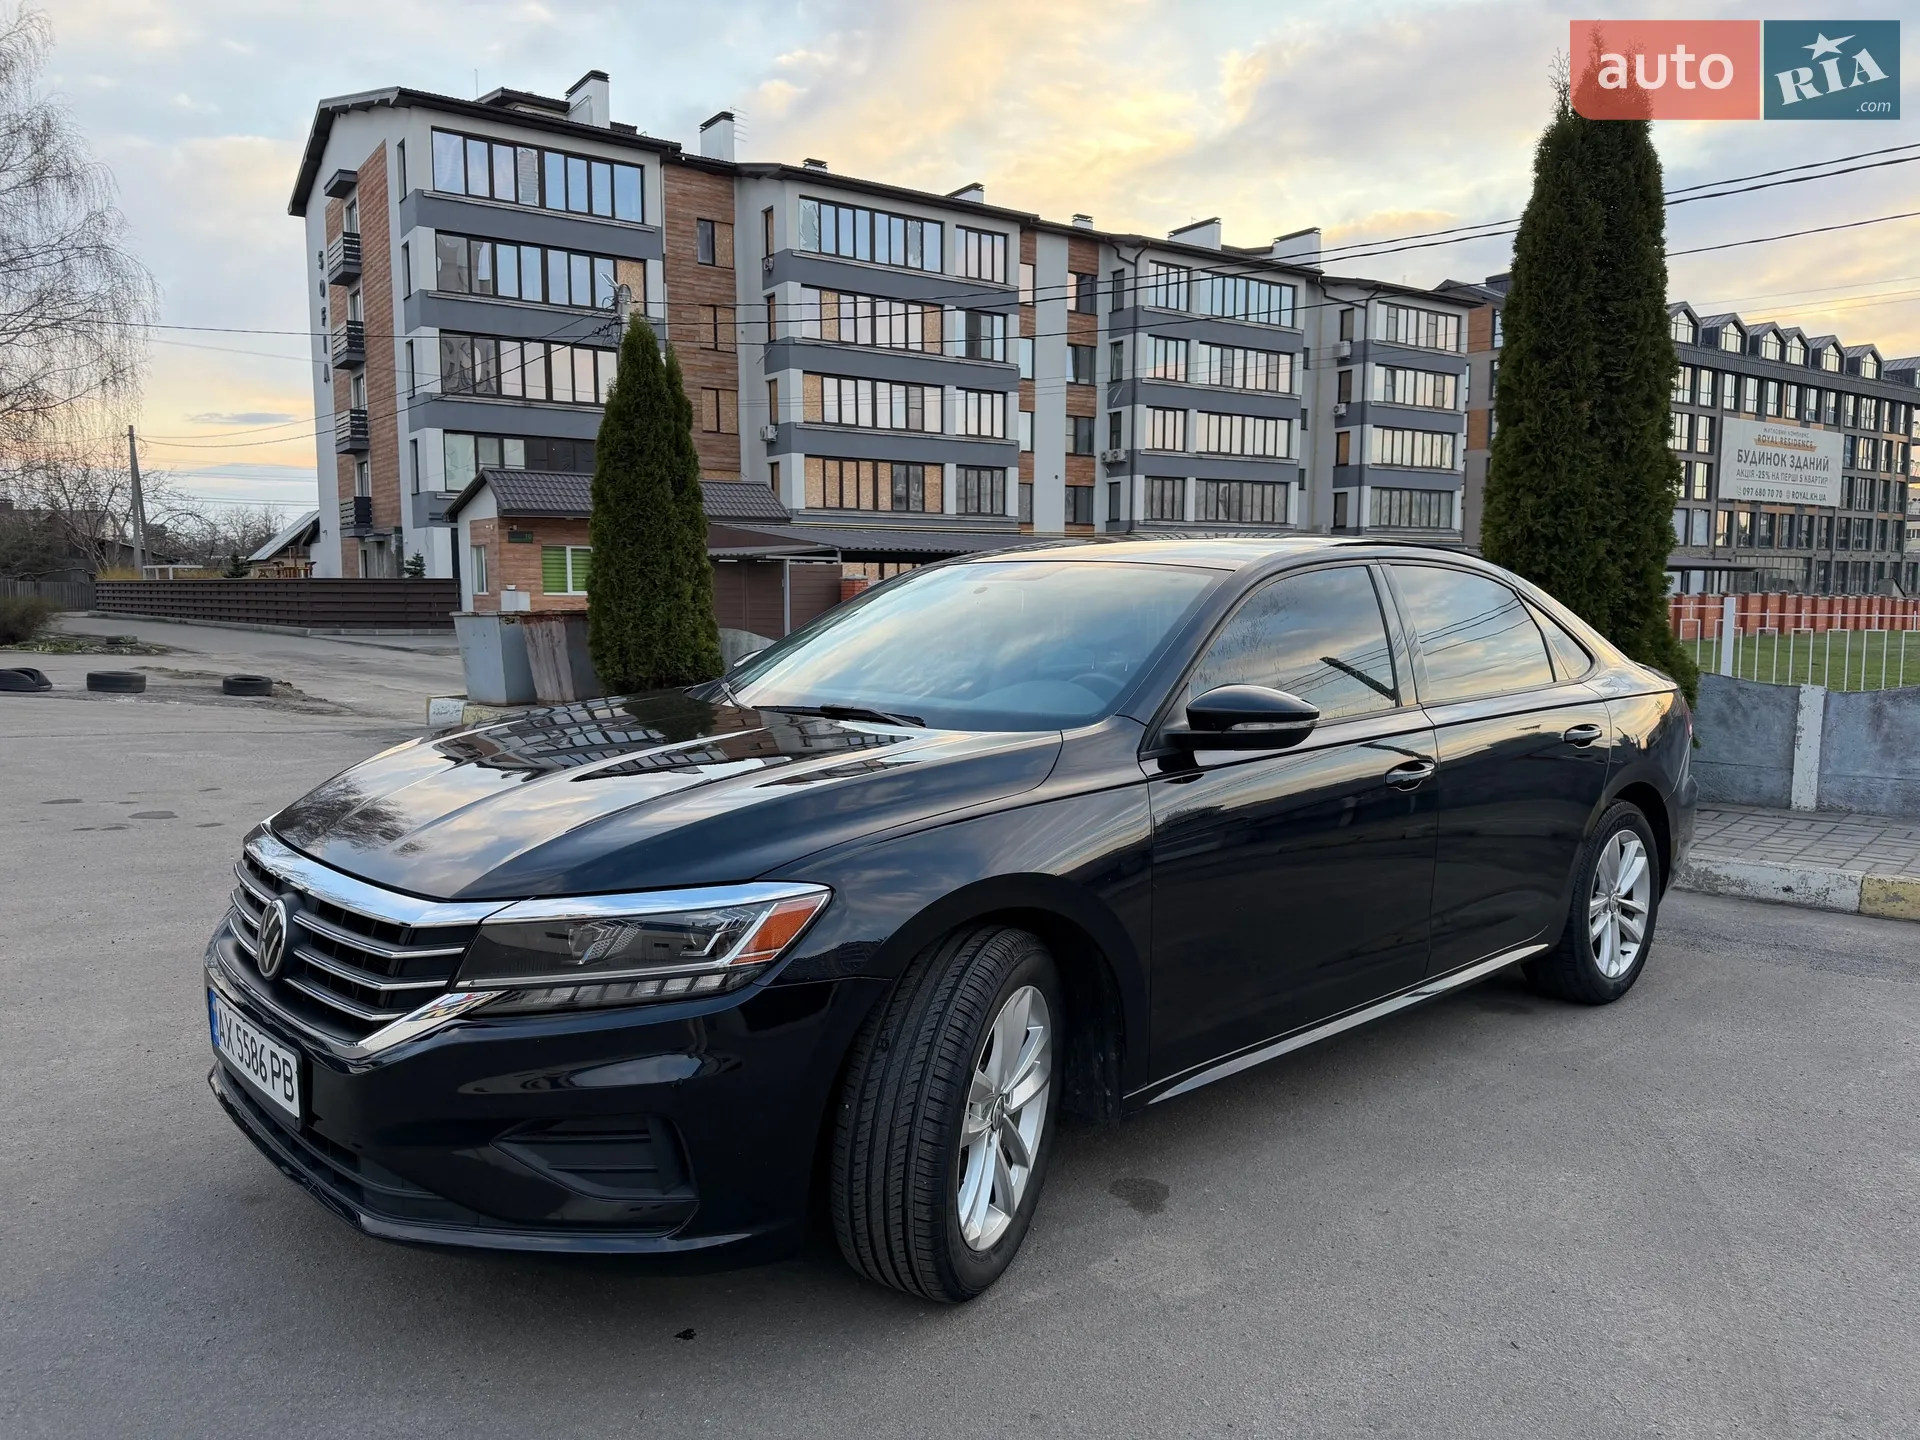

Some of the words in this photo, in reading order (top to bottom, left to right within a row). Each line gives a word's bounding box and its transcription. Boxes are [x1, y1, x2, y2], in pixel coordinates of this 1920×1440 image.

[1757, 434, 1778, 445] ROYAL
[1780, 437, 1814, 449] RESIDENCE
[1737, 449, 1787, 468] БУДИНОК
[1789, 455, 1829, 472] ЗДАНИЙ
[1736, 468, 1755, 478] АКЦІЯ
[1755, 470, 1770, 480] -25%
[1771, 472, 1780, 481] НА
[1780, 472, 1798, 482] ПЕРШІ
[1804, 475, 1828, 485] КВАРТИР
[1742, 487, 1754, 496] 097
[1755, 488, 1766, 497] 680
[1767, 489, 1775, 498] 70
[1775, 489, 1783, 499] 70
[1791, 490, 1827, 502] ROYAL.KH.UA
[218, 1007, 235, 1056] AX
[235, 1022, 268, 1084] 5586
[270, 1049, 294, 1103] PB
